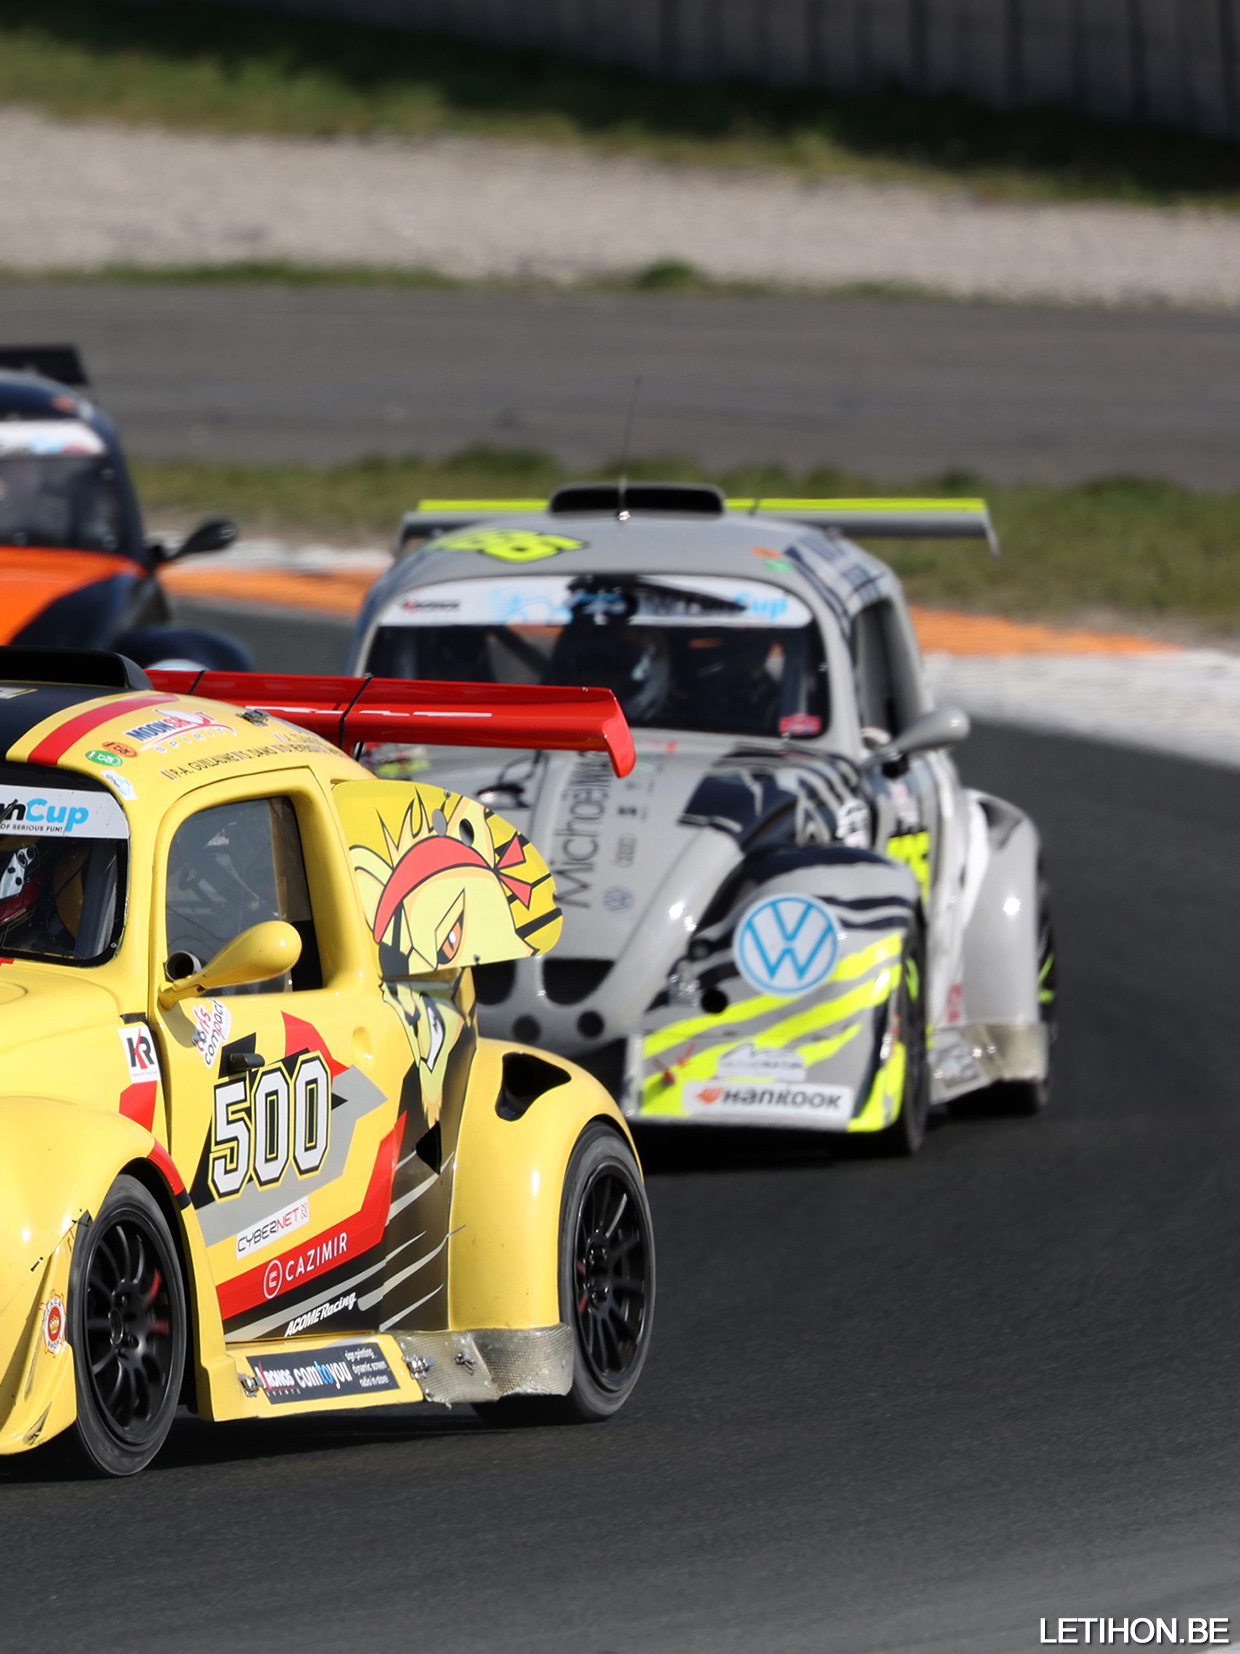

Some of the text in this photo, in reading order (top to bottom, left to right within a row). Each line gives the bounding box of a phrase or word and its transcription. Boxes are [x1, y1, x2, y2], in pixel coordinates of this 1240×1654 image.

[207, 1050, 332, 1203] 500
[237, 1206, 301, 1252] CYBERNET
[285, 1232, 348, 1281] CAZIMIR
